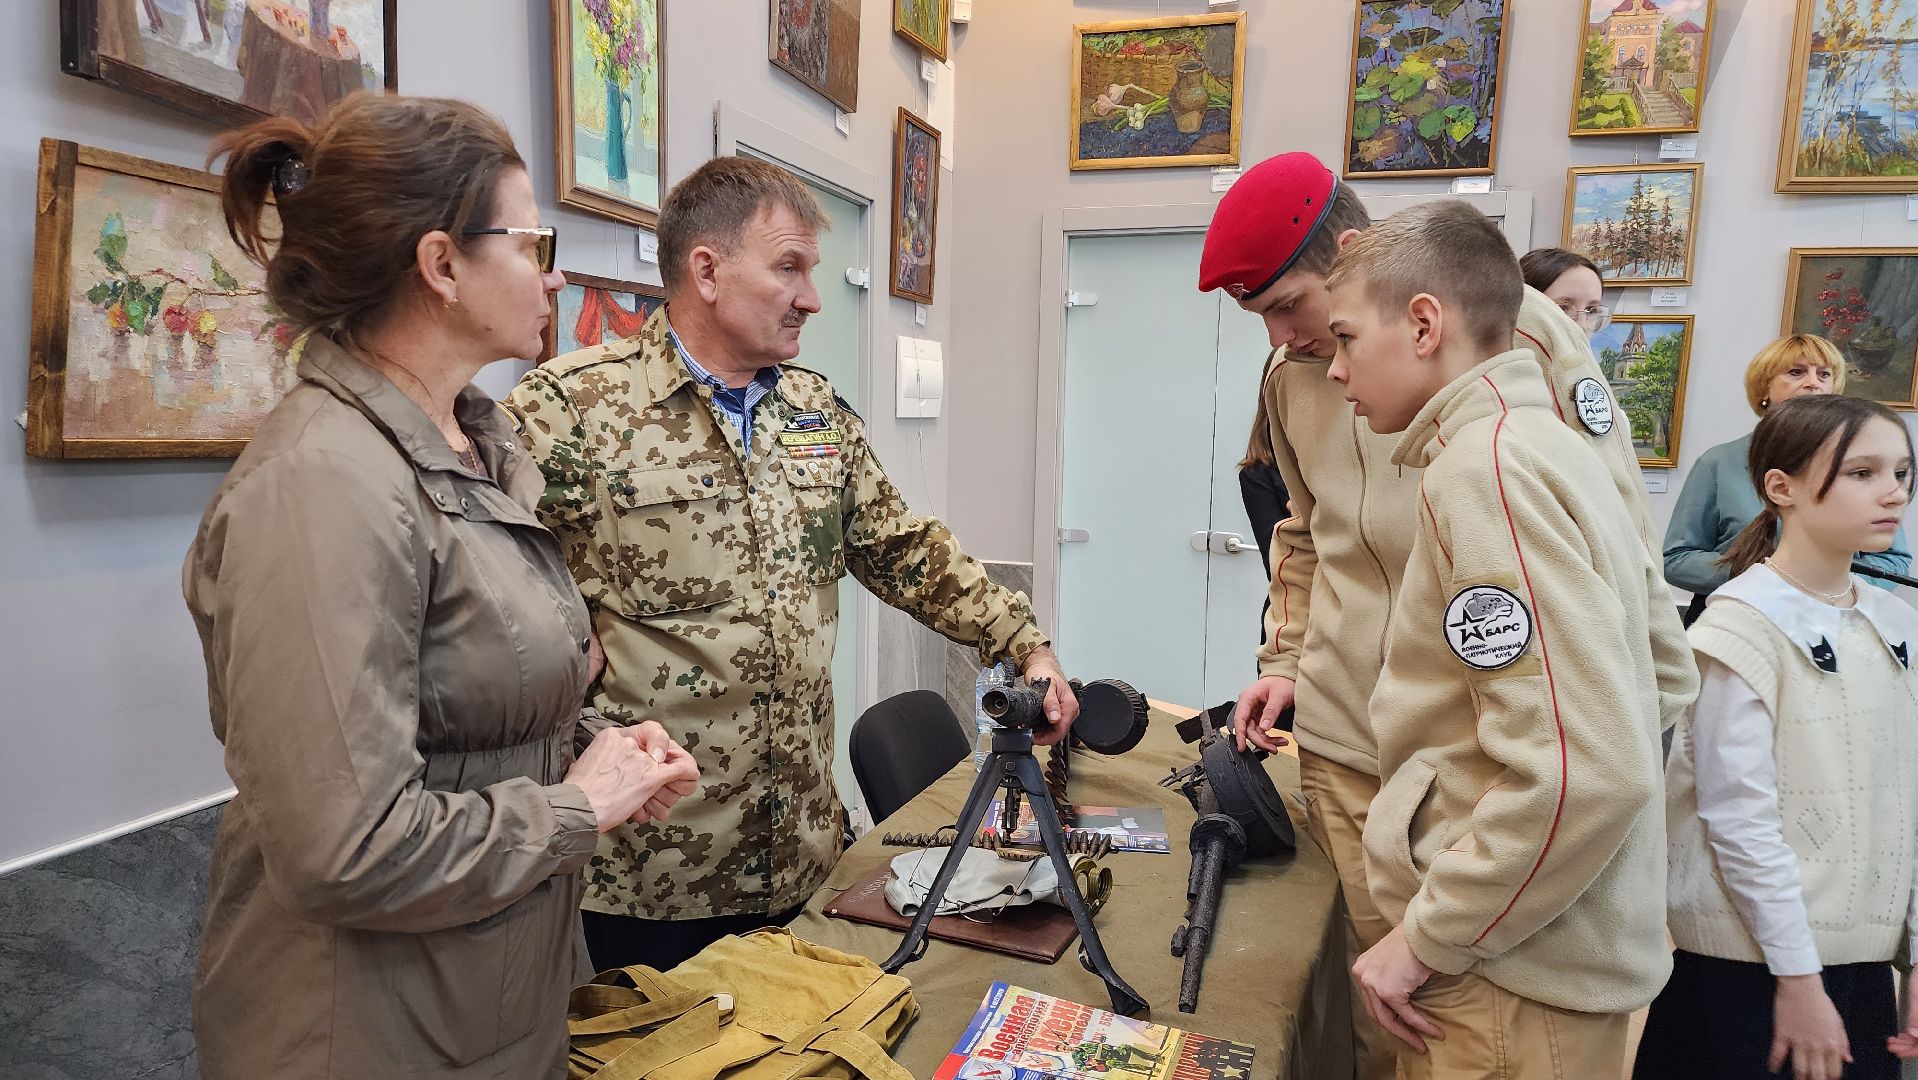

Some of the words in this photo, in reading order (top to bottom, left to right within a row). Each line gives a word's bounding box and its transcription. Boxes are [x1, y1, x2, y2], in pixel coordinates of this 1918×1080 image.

[1485, 623, 1520, 637] БАРС
[1461, 643, 1487, 652] ВОЕННО-
[1465, 641, 1522, 658] ПАТРИОТИЧЕСКИЙ
[978, 994, 1036, 1061] Военная
